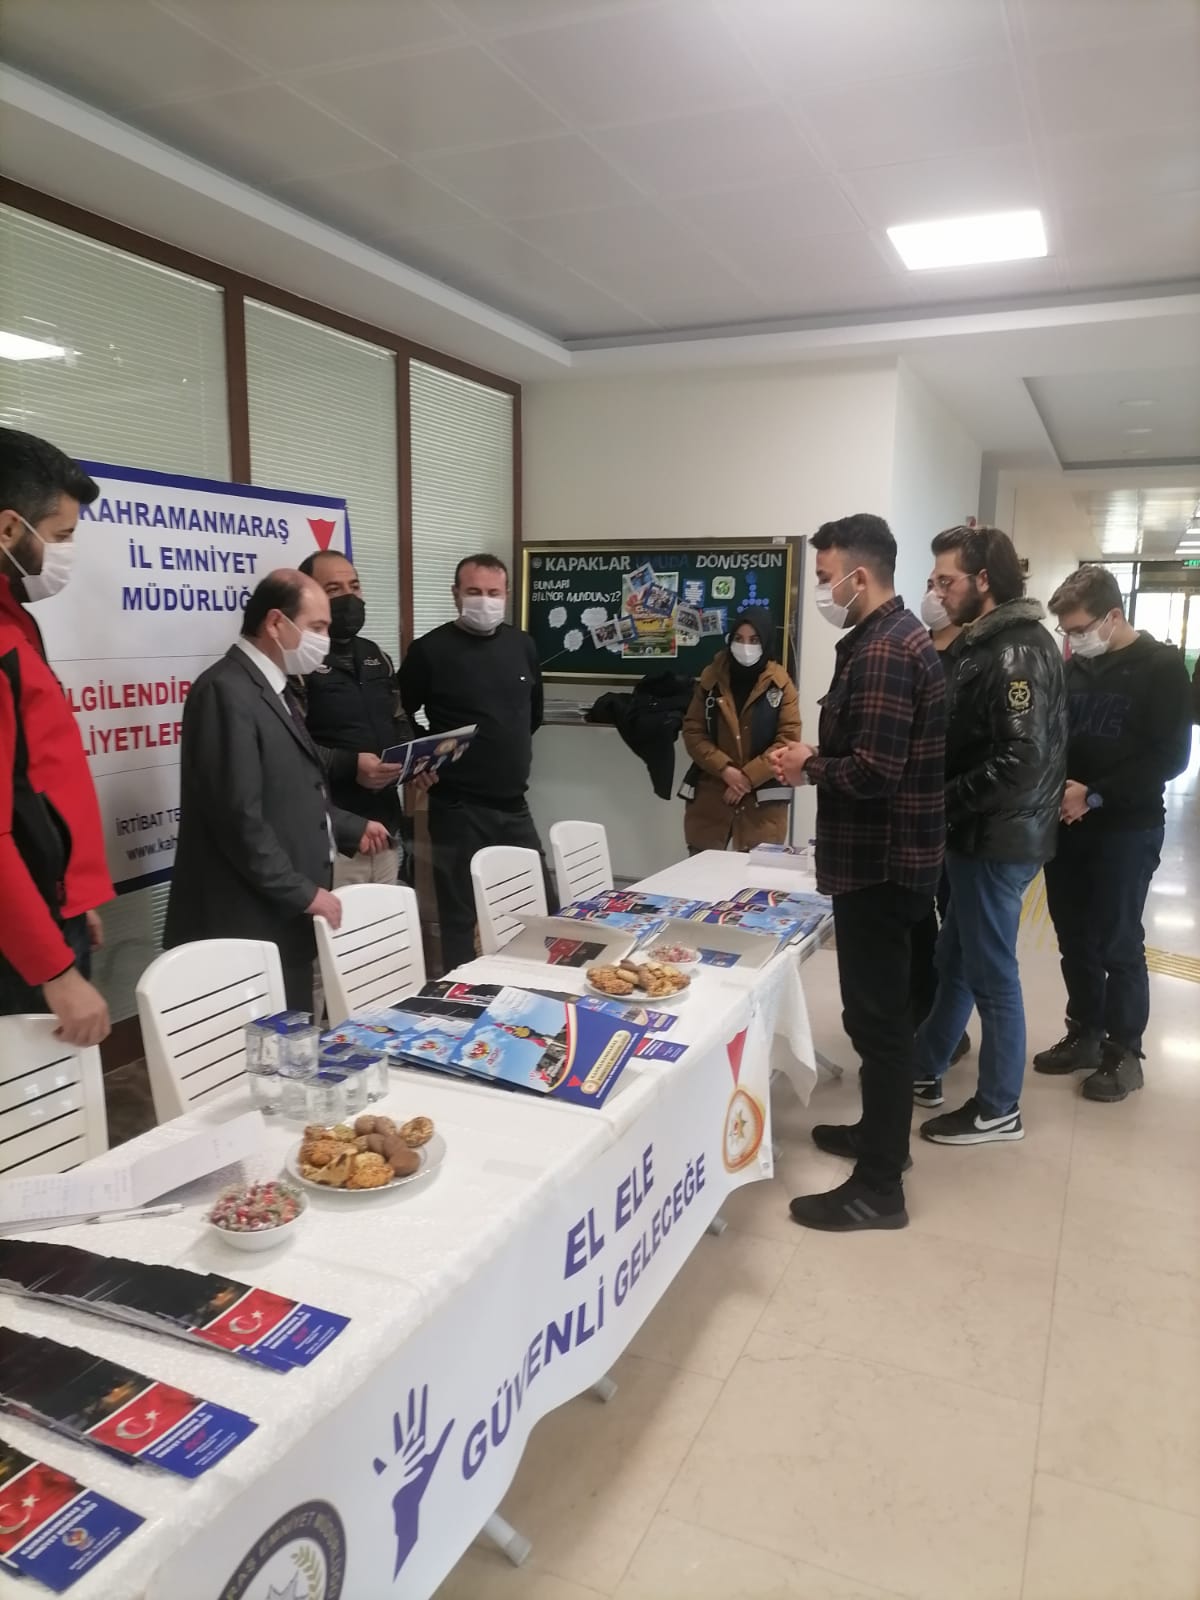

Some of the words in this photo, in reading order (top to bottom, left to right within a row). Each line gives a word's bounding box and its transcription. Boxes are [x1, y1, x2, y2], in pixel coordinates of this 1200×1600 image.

[80, 498, 289, 545] KAHRAMANMARAŞ
[129, 538, 152, 569] İL
[160, 545, 258, 574] EMNİYET
[545, 556, 631, 572] KAPAKLAR
[122, 582, 253, 612] MÜDÜRLÜĞ
[116, 810, 163, 837] İRTİBAT
[564, 1207, 605, 1280] EL
[615, 1143, 654, 1234] ELE
[462, 1274, 604, 1481] GÜVENLİ
[614, 1152, 705, 1307] GELECEĞE
